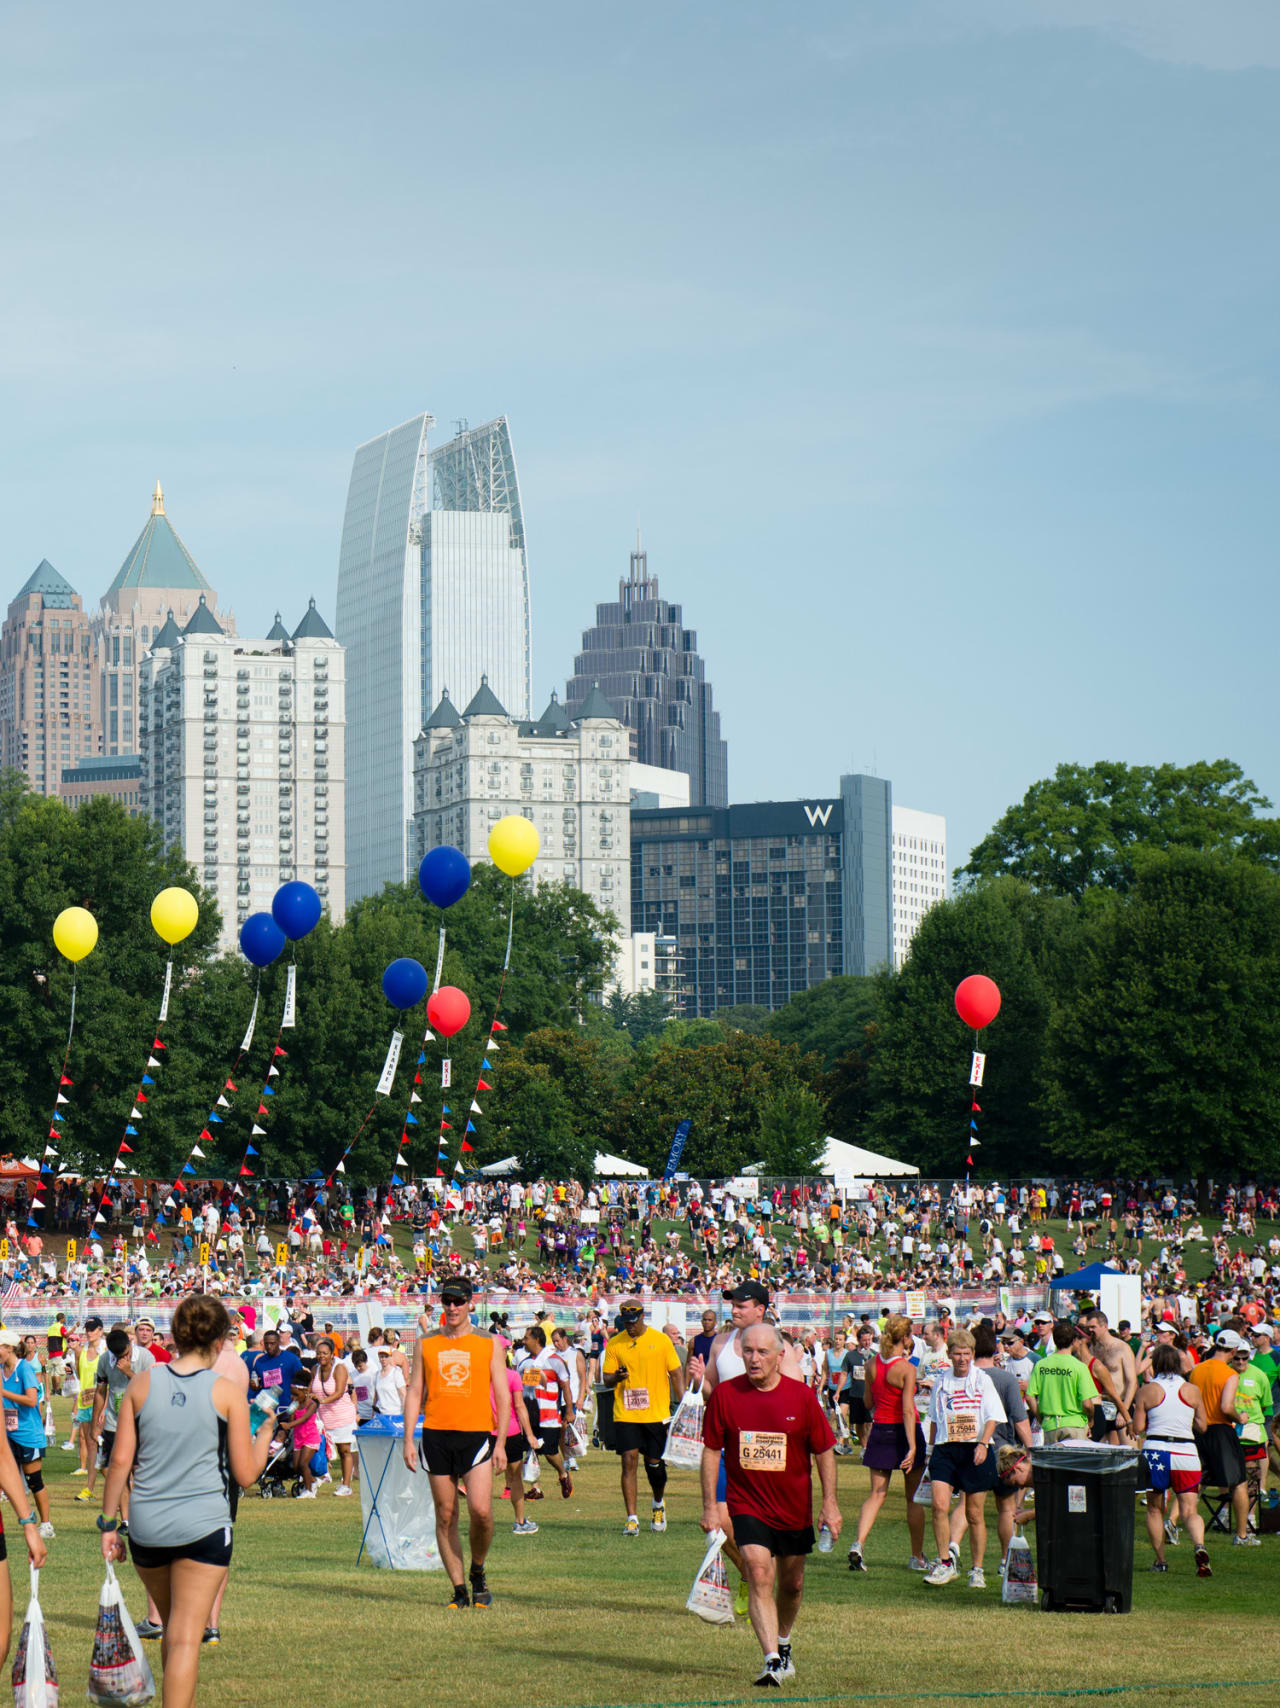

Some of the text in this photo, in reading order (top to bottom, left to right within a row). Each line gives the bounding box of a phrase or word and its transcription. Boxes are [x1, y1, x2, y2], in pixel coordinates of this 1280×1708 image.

[803, 804, 834, 827] W
[666, 1131, 686, 1173] EMORY
[1039, 1367, 1072, 1377] Reebok
[743, 1447, 782, 1459] G 25441
